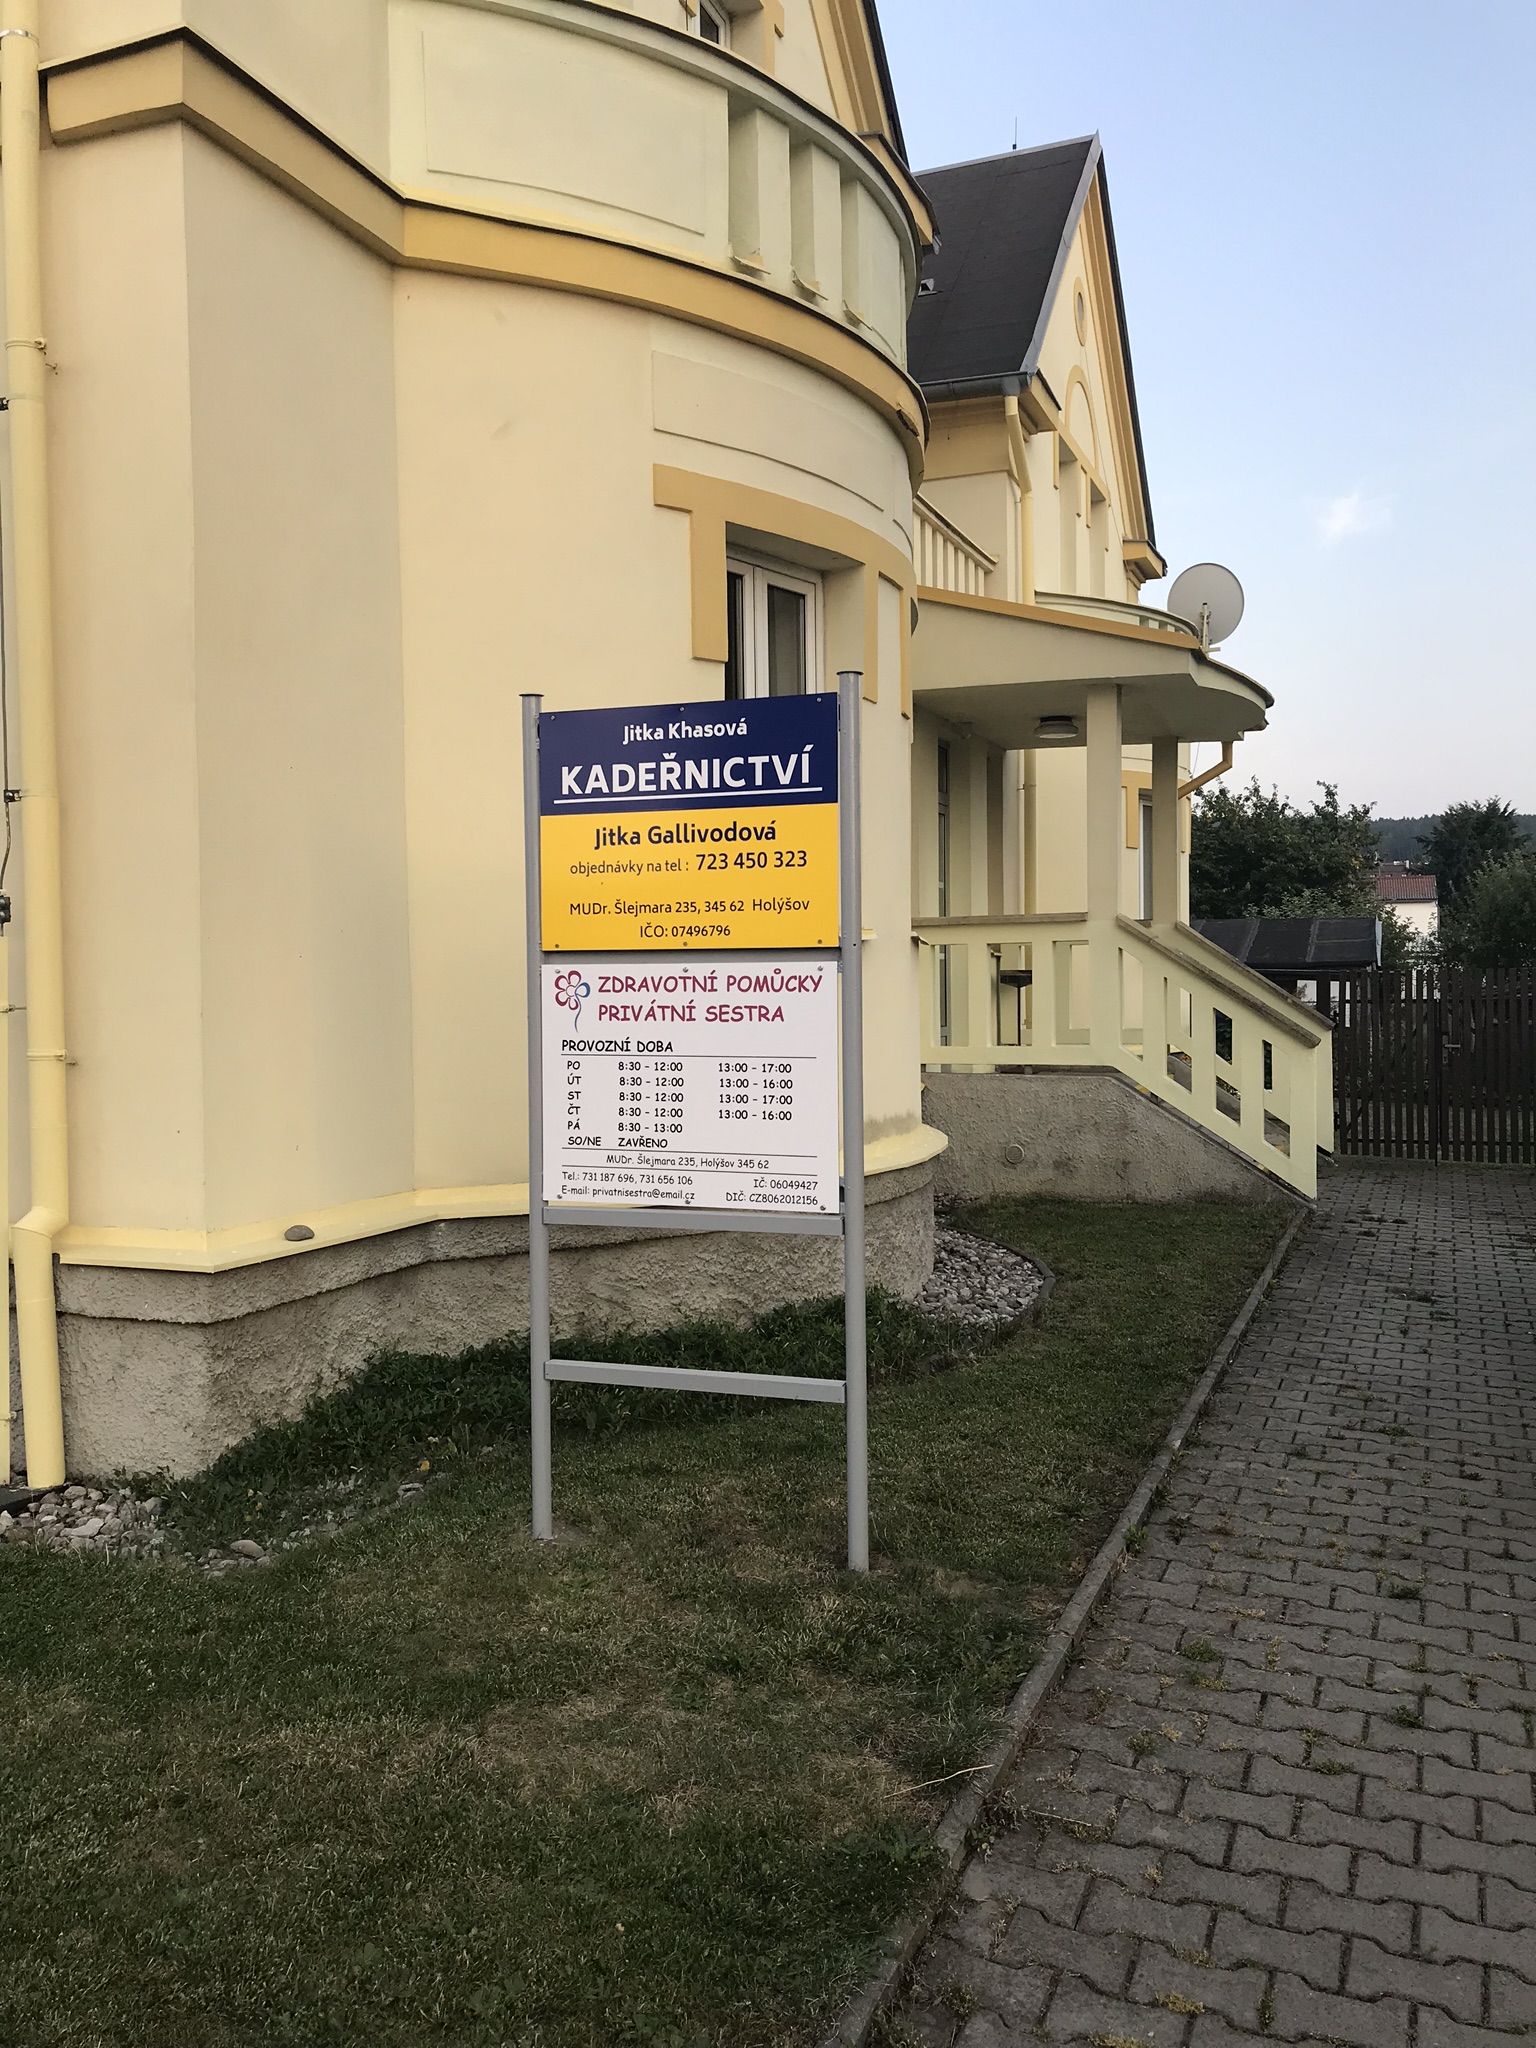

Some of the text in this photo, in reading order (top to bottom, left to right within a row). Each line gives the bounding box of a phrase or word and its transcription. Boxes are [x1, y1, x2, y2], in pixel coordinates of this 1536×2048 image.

[622, 718, 747, 745] Jitka Khasová
[561, 744, 814, 795] KADEŘNICTVÍ
[594, 820, 776, 850] Jitka Gallivodová
[570, 860, 643, 877] objednávky
[647, 863, 661, 872] na
[665, 858, 681, 871] tel
[696, 853, 728, 870] 723
[734, 852, 767, 869] 450
[774, 850, 807, 867] 323
[570, 897, 810, 917] MUDr. Šlejmara 235, 345 62 Holýšov
[640, 922, 730, 938] IČO: 07496796
[597, 967, 823, 994] ZDRAVOTNÍ POMŮCKY
[598, 999, 784, 1022] PRIVÁTNÍ SESTRA
[562, 1037, 673, 1052] PROVOZNÍ DOBA
[567, 1061, 580, 1070] PO
[619, 1062, 641, 1071] 8:30
[655, 1062, 683, 1071] 12:00
[719, 1063, 747, 1072] 13:00
[762, 1064, 791, 1073] 17:00
[568, 1073, 581, 1085] ÚT
[620, 1077, 642, 1086] 8:30
[656, 1077, 684, 1087] 12:00
[720, 1079, 749, 1088] 13:00
[764, 1079, 793, 1089] 16:00
[568, 1091, 581, 1100] ST
[619, 1092, 641, 1101] 8:30
[656, 1093, 683, 1102] 12:00
[720, 1094, 748, 1103] 13:00
[763, 1095, 792, 1105] 17:00
[568, 1103, 580, 1115] ČT
[619, 1107, 641, 1116] 8:30
[655, 1108, 683, 1117] 12:00
[719, 1110, 748, 1119] 13:00
[763, 1111, 792, 1120] 16:00
[568, 1118, 580, 1130] PÁ
[618, 1123, 640, 1132] 8:30
[655, 1123, 682, 1133] 13:00
[568, 1135, 667, 1148] SO/NE ZAVŘENO
[606, 1152, 769, 1170] MUDr. Šlejmara 235, Holýšov 345 62
[562, 1171, 692, 1185] Tel.: 731 187 696, 731 656 106
[754, 1177, 818, 1190] IČ: 06049427
[562, 1185, 695, 1201] E-mail: privatnisestra@email.cz
[726, 1190, 818, 1205] DIČ: CZ8062012156
